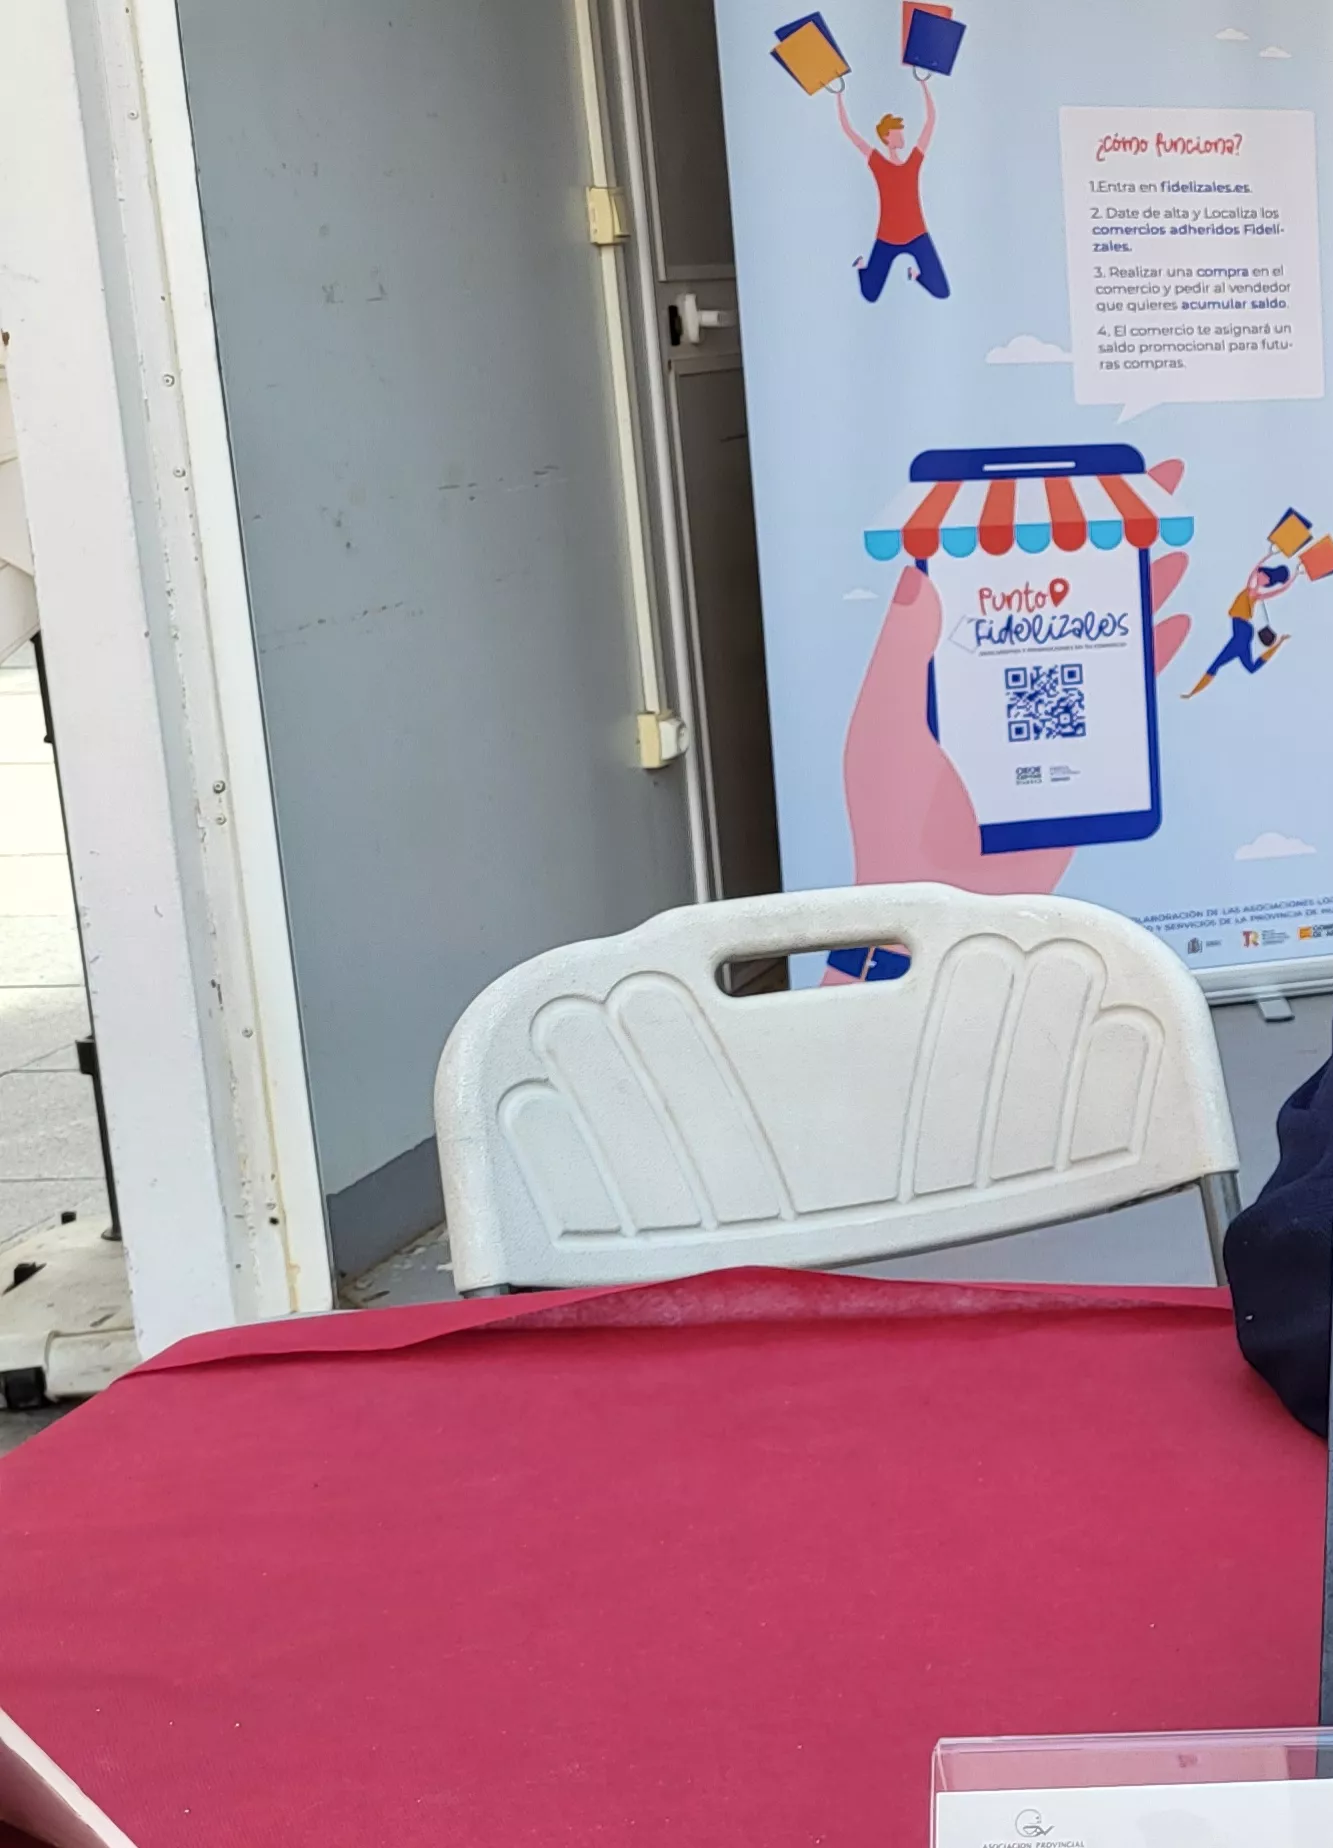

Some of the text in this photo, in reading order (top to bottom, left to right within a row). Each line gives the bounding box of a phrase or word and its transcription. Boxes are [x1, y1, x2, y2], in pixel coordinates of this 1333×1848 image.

[1156, 133, 1242, 156] funciona?
[1139, 182, 1157, 193] en
[1090, 207, 1279, 222] 2. Date de alta y Localiza los
[1093, 225, 1166, 236] comercios
[1170, 224, 1240, 236] adheridos
[1093, 241, 1132, 253] zales.
[1094, 266, 1283, 280] 3. Realizar una compra en el
[1096, 282, 1291, 296] comercio y pedir al vendedor
[1097, 299, 1289, 313] que quieres acumular saldo.
[1098, 323, 1291, 337] 4. El comercio te asignará un
[1098, 339, 1293, 355] saldo promocional para futu-
[1100, 358, 1186, 371] ras compras.
[1223, 906, 1240, 915] LAS
[1243, 900, 1314, 912] ASOCIACIONES
[1165, 919, 1216, 931] SERVICIOS
[1219, 917, 1231, 925] DE
[1250, 911, 1302, 922] PROVINCIA
